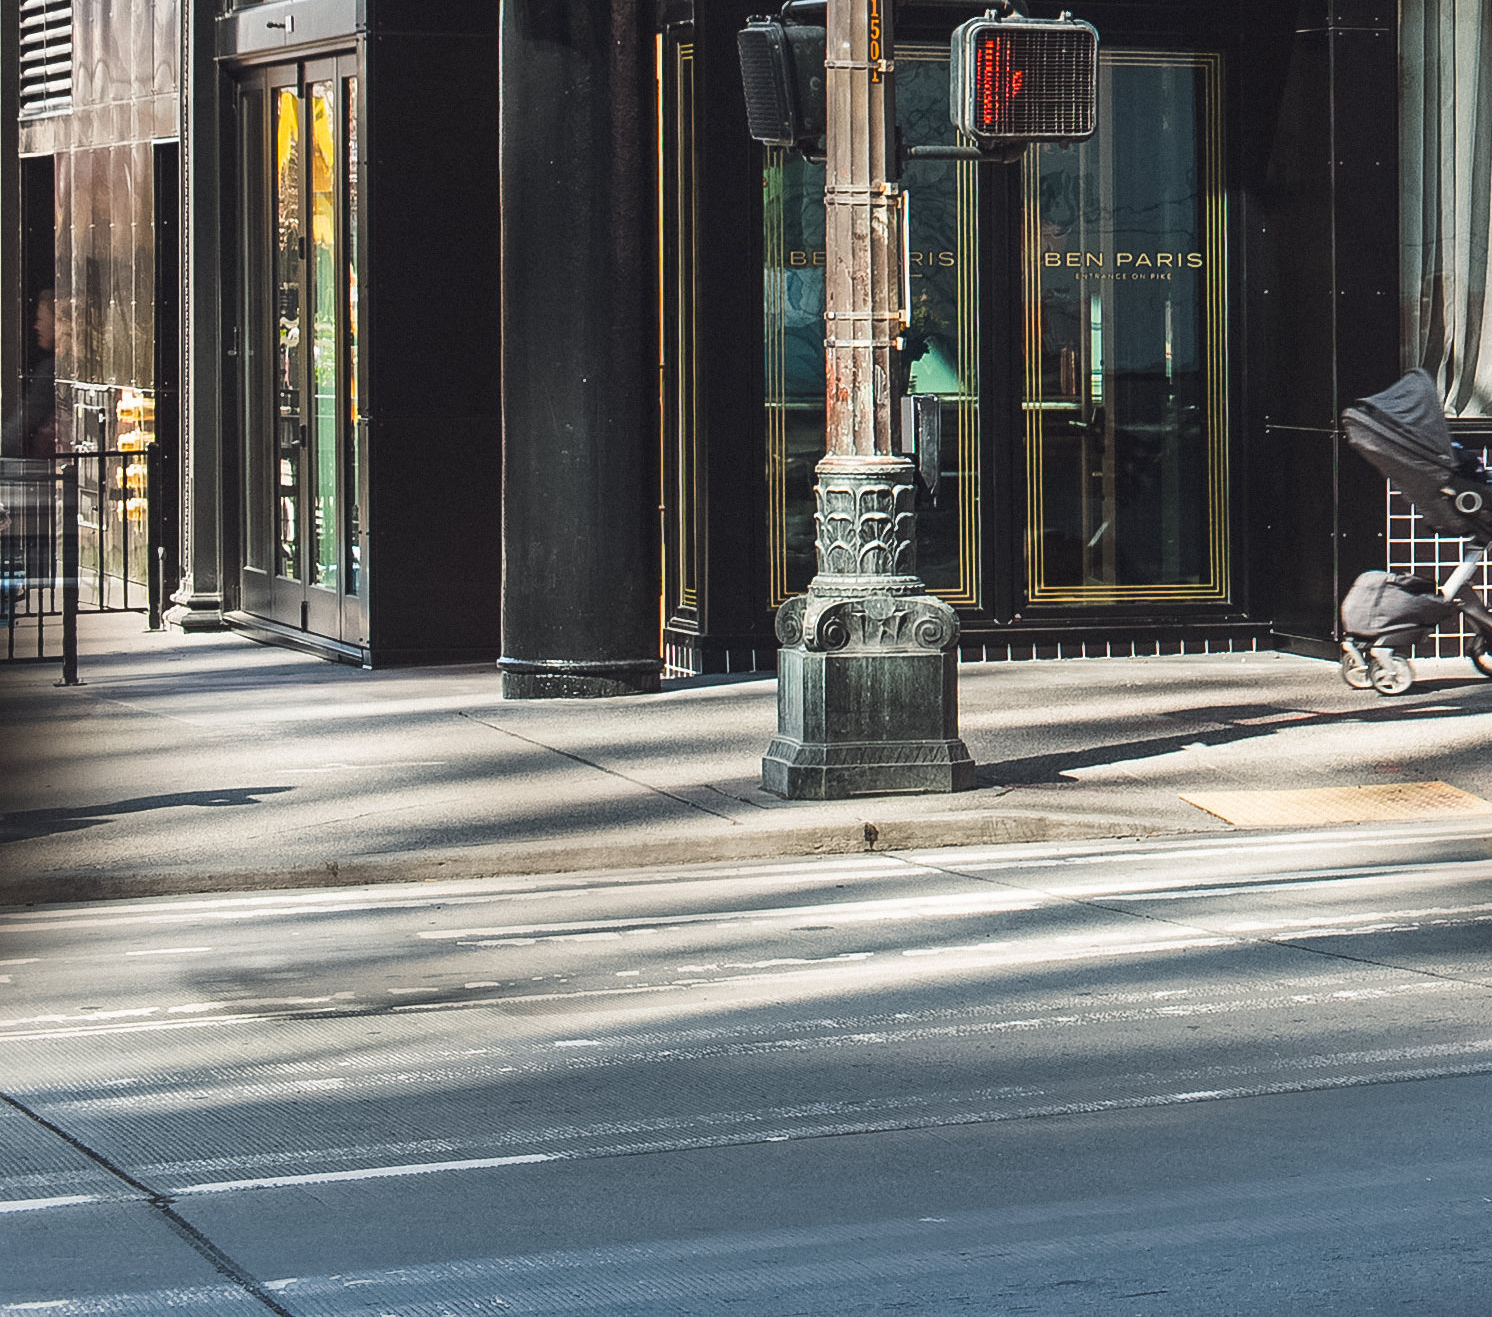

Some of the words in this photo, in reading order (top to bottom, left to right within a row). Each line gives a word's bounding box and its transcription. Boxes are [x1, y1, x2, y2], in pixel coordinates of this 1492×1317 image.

[789, 250, 826, 266] BE
[908, 251, 955, 267] RIS
[1044, 251, 1104, 268] BEN
[1116, 251, 1204, 269] PARIS
[1074, 272, 1127, 281] ENTRANCE
[1131, 272, 1146, 281] ON
[1150, 272, 1173, 281] PIKE
